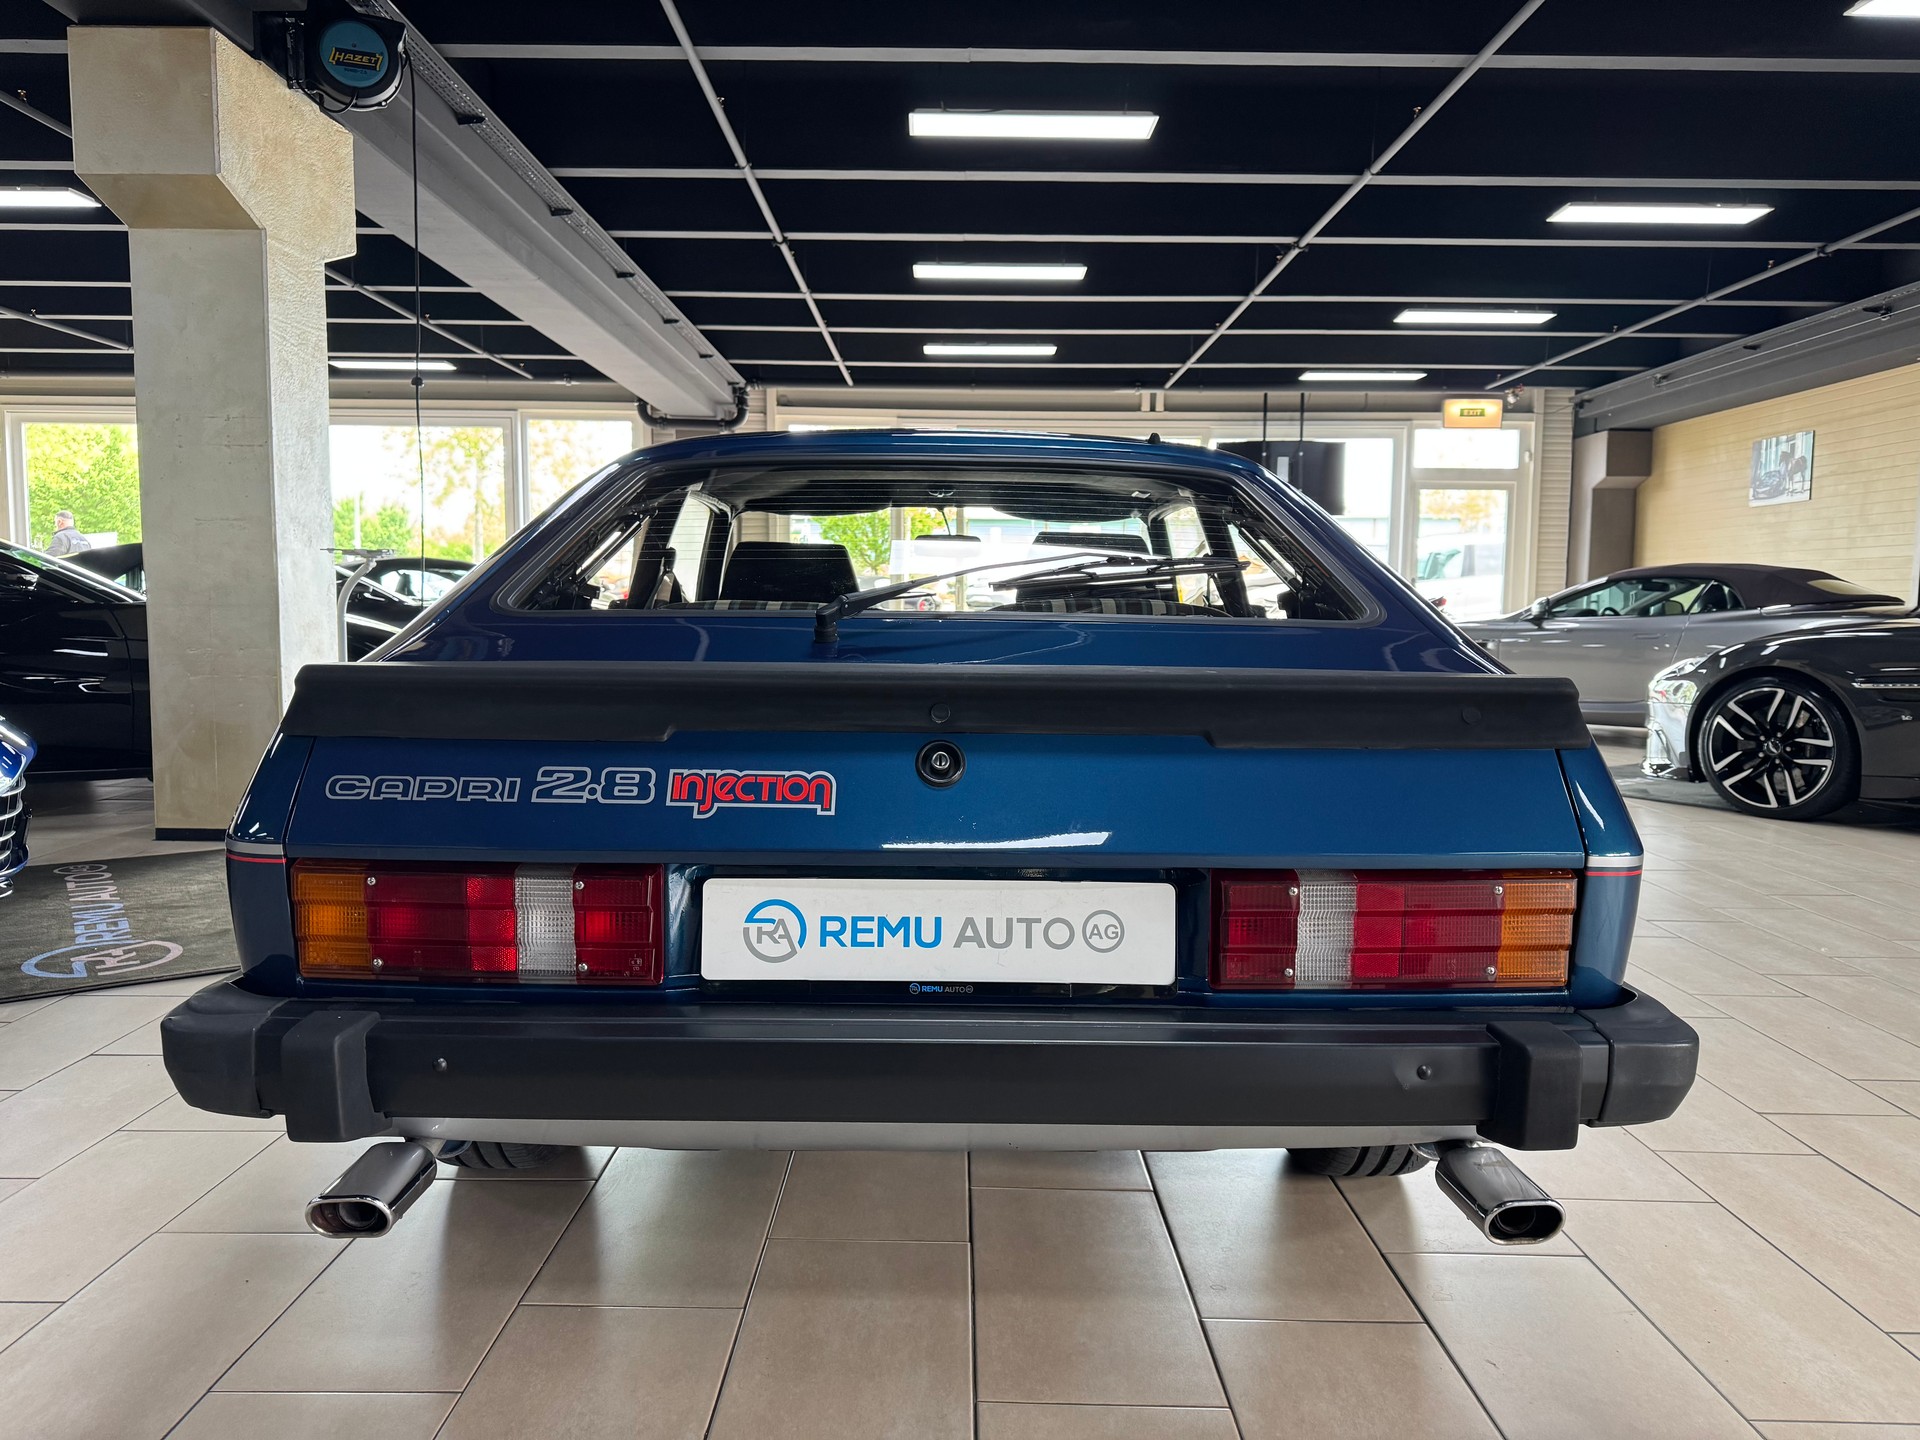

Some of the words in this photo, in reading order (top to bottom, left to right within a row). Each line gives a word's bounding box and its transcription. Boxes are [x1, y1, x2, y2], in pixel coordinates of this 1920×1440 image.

[335, 51, 377, 64] HAZET
[325, 774, 521, 802] CAPRI
[531, 766, 656, 804] 2.8
[64, 872, 120, 901] AUTO
[71, 903, 132, 944] REMU
[819, 915, 942, 949] REMU
[953, 916, 1076, 950] AUTO
[1088, 923, 1119, 941] AG
